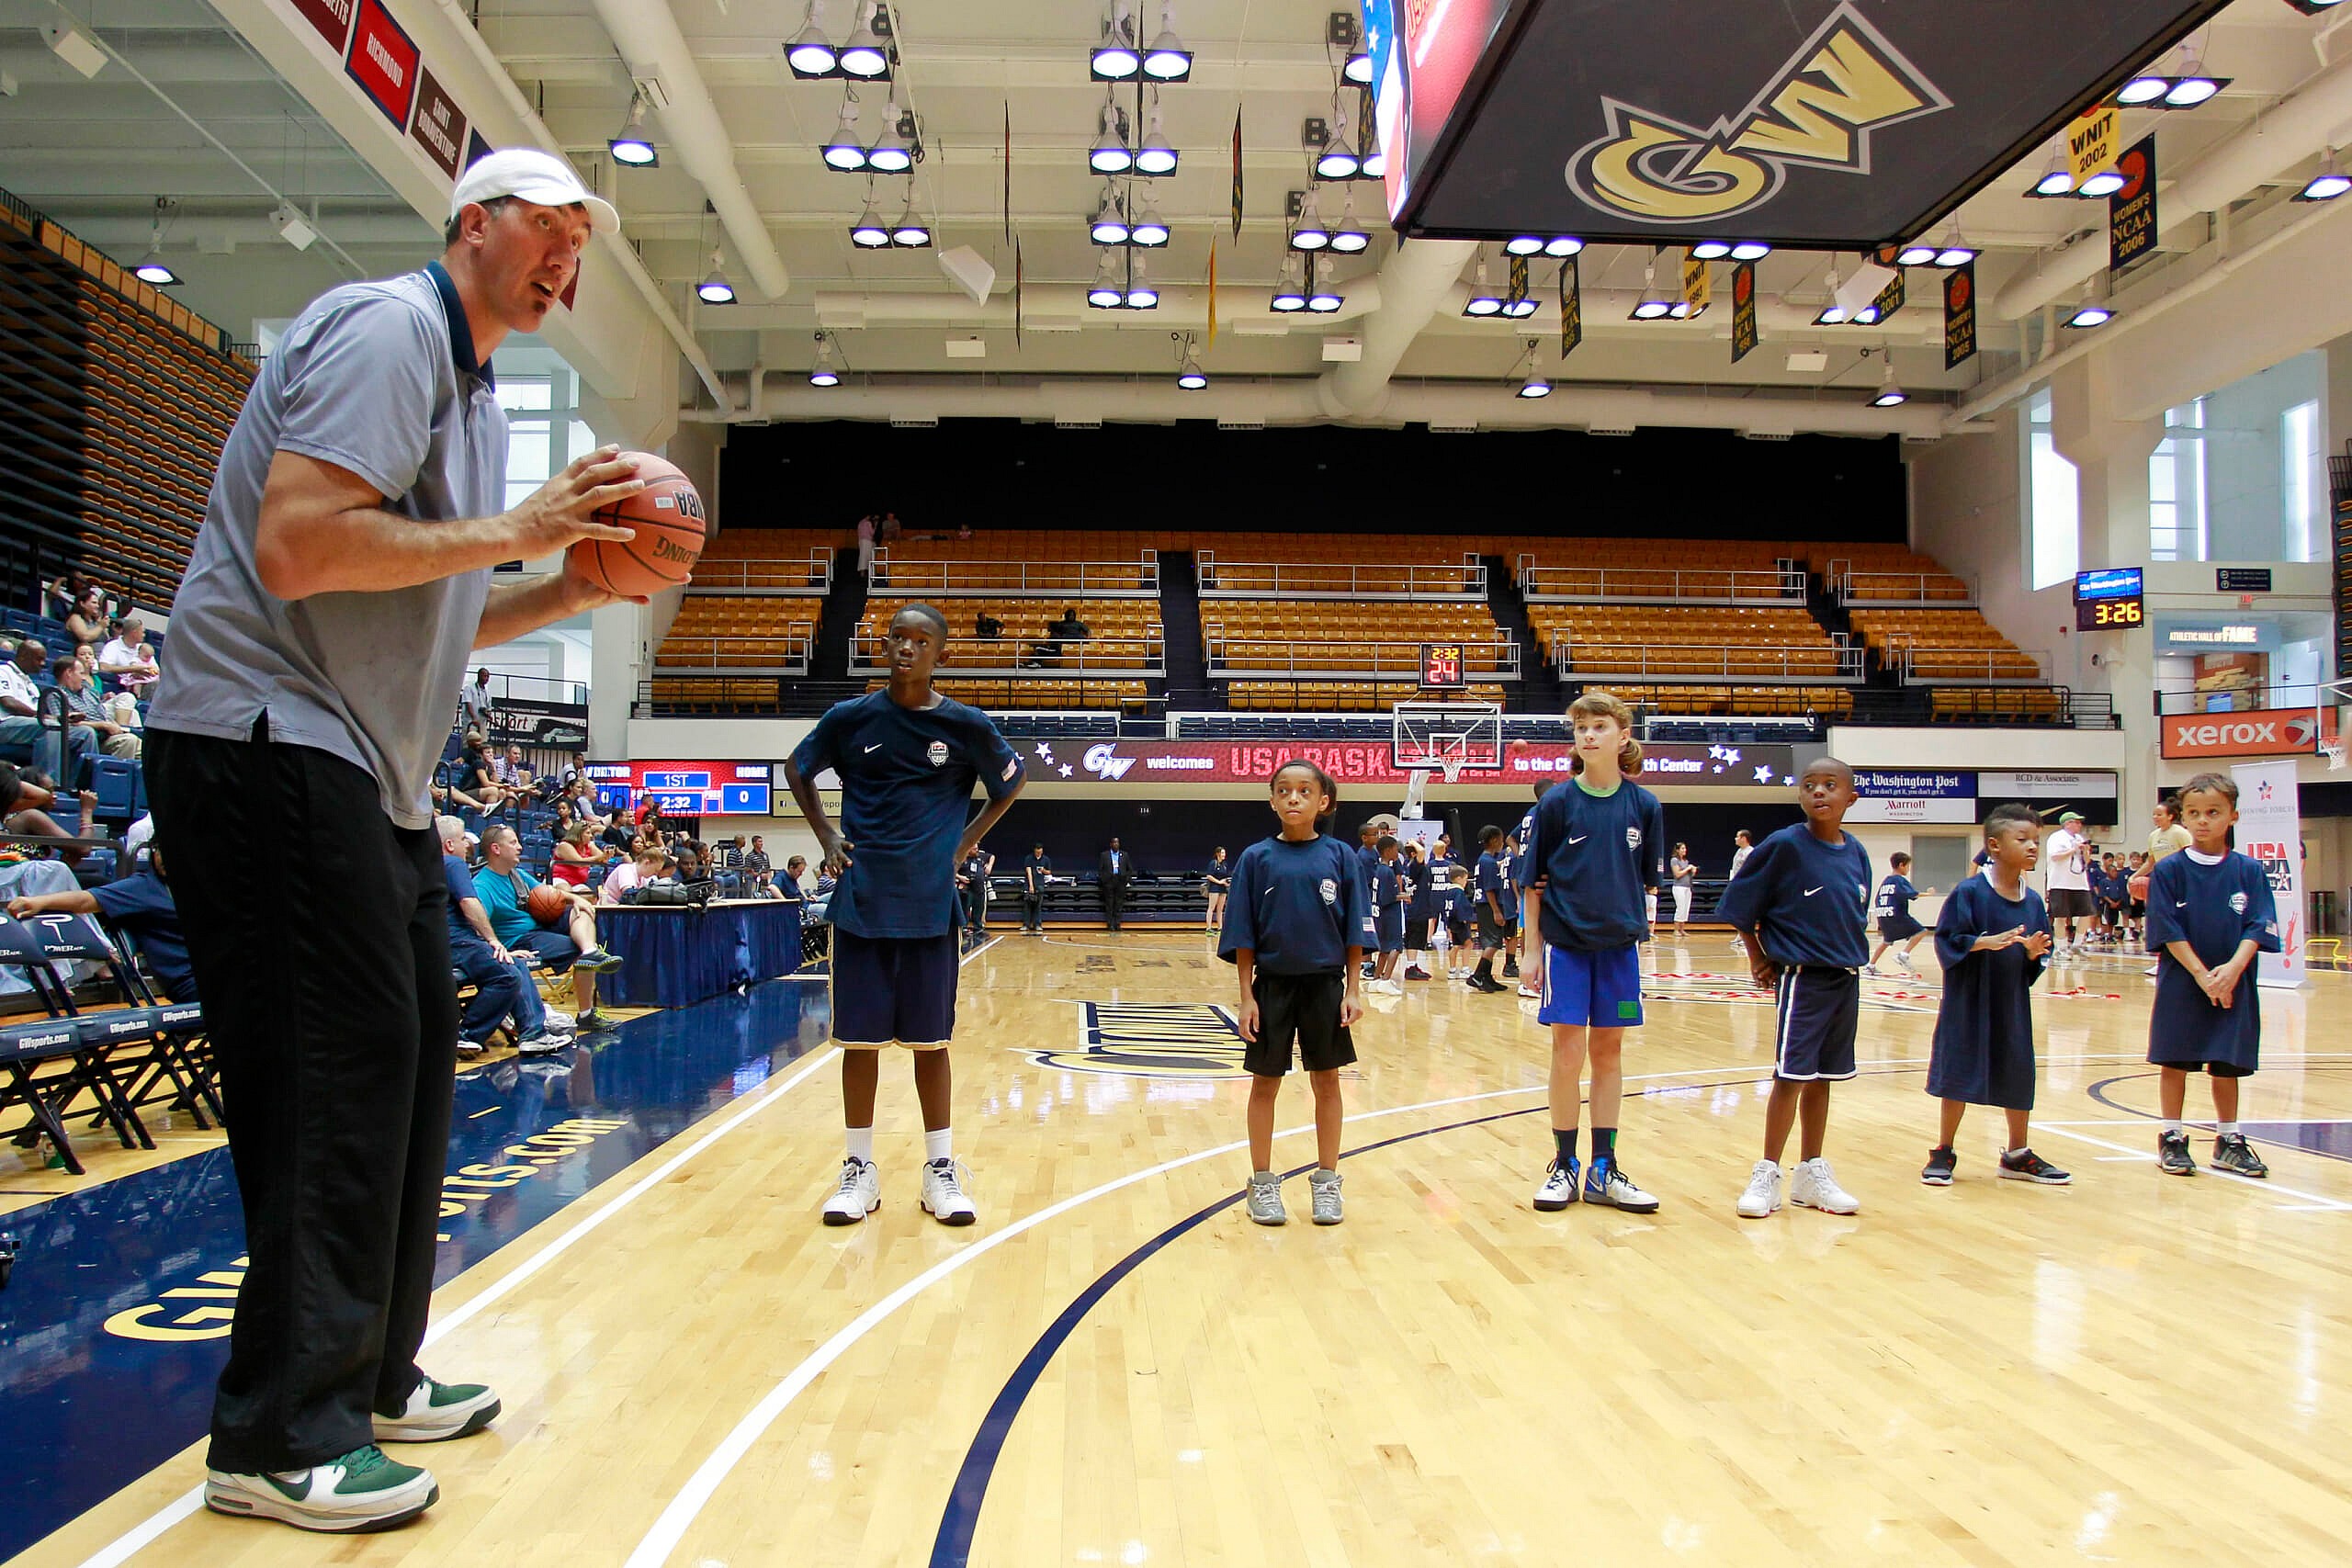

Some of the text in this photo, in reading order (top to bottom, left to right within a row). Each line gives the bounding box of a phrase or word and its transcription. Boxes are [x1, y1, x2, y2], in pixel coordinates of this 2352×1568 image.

[367, 32, 403, 88] RICHMOND
[433, 97, 450, 130] SAINT
[2070, 112, 2113, 156] WNIT
[2079, 143, 2108, 174] 2002
[2112, 209, 2153, 245] NCAA
[2118, 232, 2145, 258] 2006
[2096, 602, 2141, 625] 3:26
[2222, 626, 2256, 643] FAME
[1432, 648, 1458, 660] 2:32
[1429, 660, 1455, 682] 24
[2177, 721, 2276, 747] xerox
[735, 766, 768, 778] HOME
[1146, 755, 1214, 770] welcomes
[1514, 757, 1529, 772] to
[1531, 757, 1554, 772] the
[1659, 758, 1702, 773] Center
[664, 774, 688, 787] 1ST
[1853, 773, 1959, 790] The Washington Post
[662, 796, 691, 808] 2:32
[740, 791, 750, 803] 0
[1885, 800, 1926, 810] Marriott
[162, 1009, 201, 1023] GWsports.com
[109, 1020, 149, 1034] GWsports.com
[18, 1033, 70, 1049] GWsports.com
